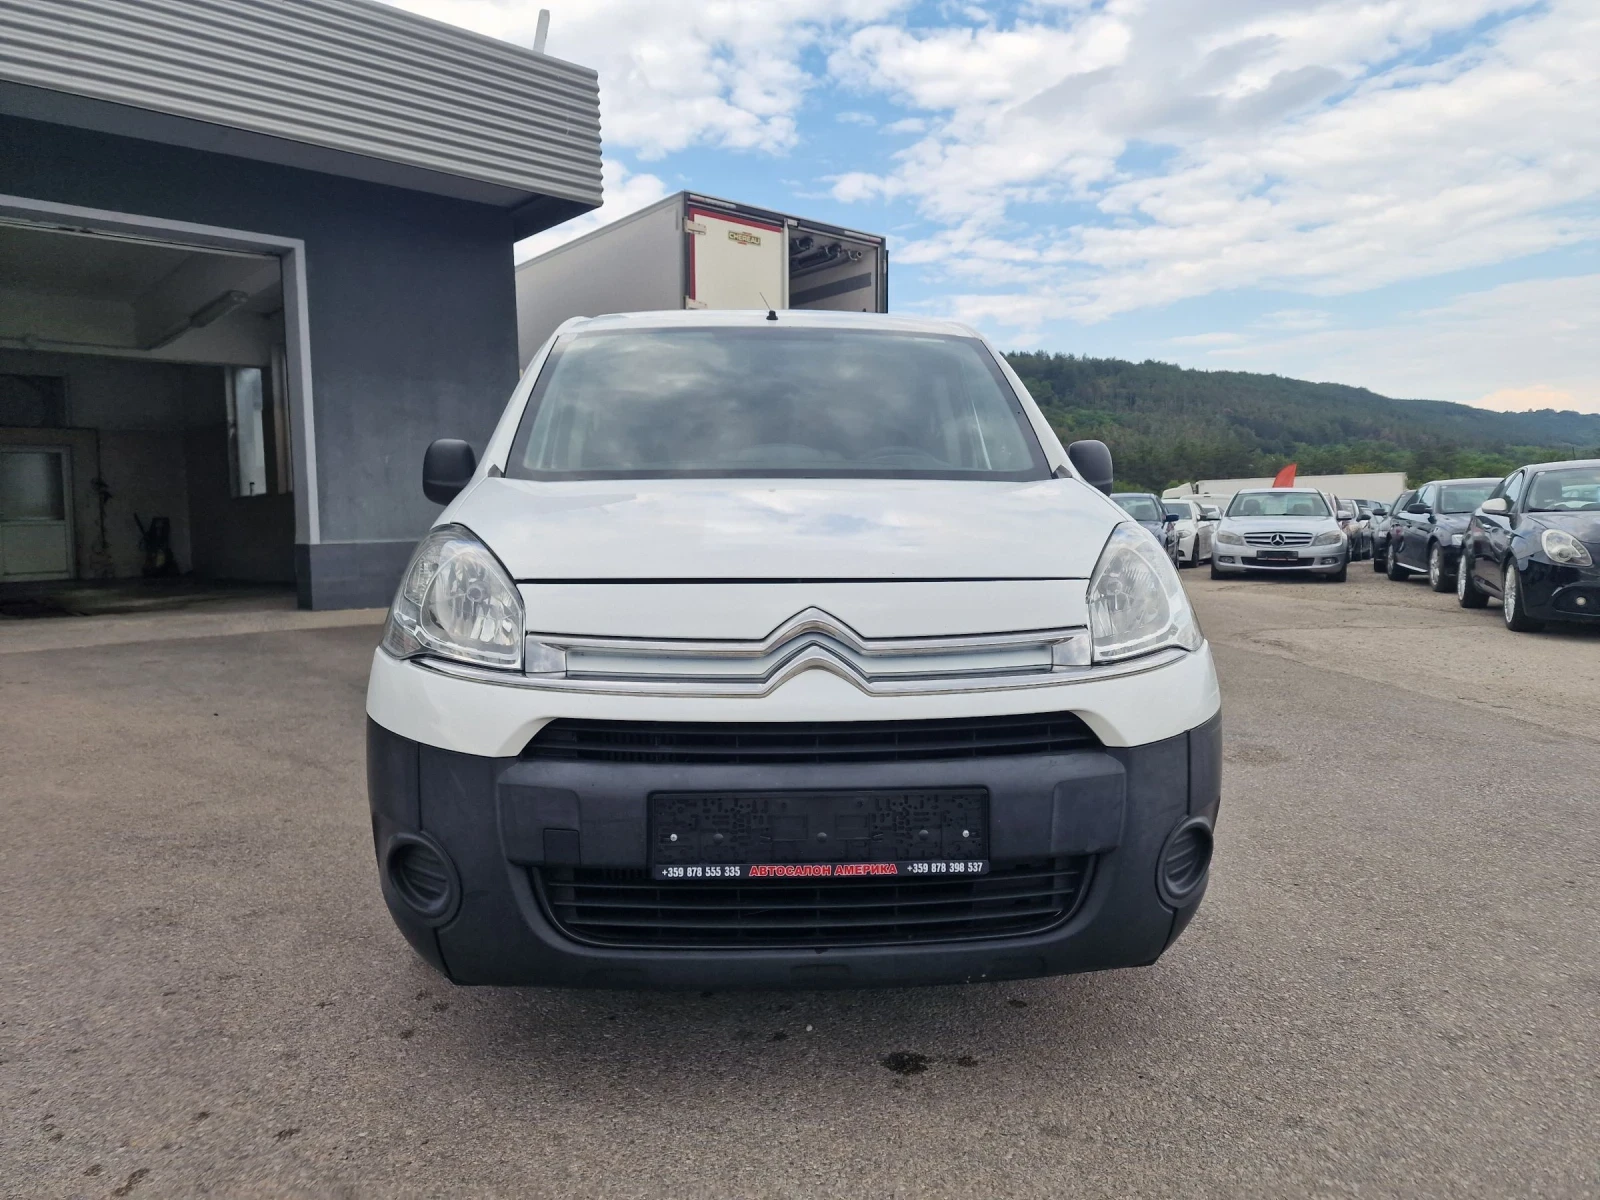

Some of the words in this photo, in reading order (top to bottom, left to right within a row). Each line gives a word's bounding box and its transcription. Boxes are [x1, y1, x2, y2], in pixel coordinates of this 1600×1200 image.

[729, 231, 760, 245] CHEREAU
[662, 867, 684, 877] +359
[687, 866, 703, 877] 878
[705, 866, 721, 877] 555
[724, 866, 740, 877] 335
[749, 865, 831, 877] АВТОСАЛОН
[834, 863, 897, 876] АМЕРИКА
[907, 863, 928, 874] +359
[931, 862, 946, 873] 878
[949, 862, 965, 873] 398
[967, 862, 983, 872] 537
